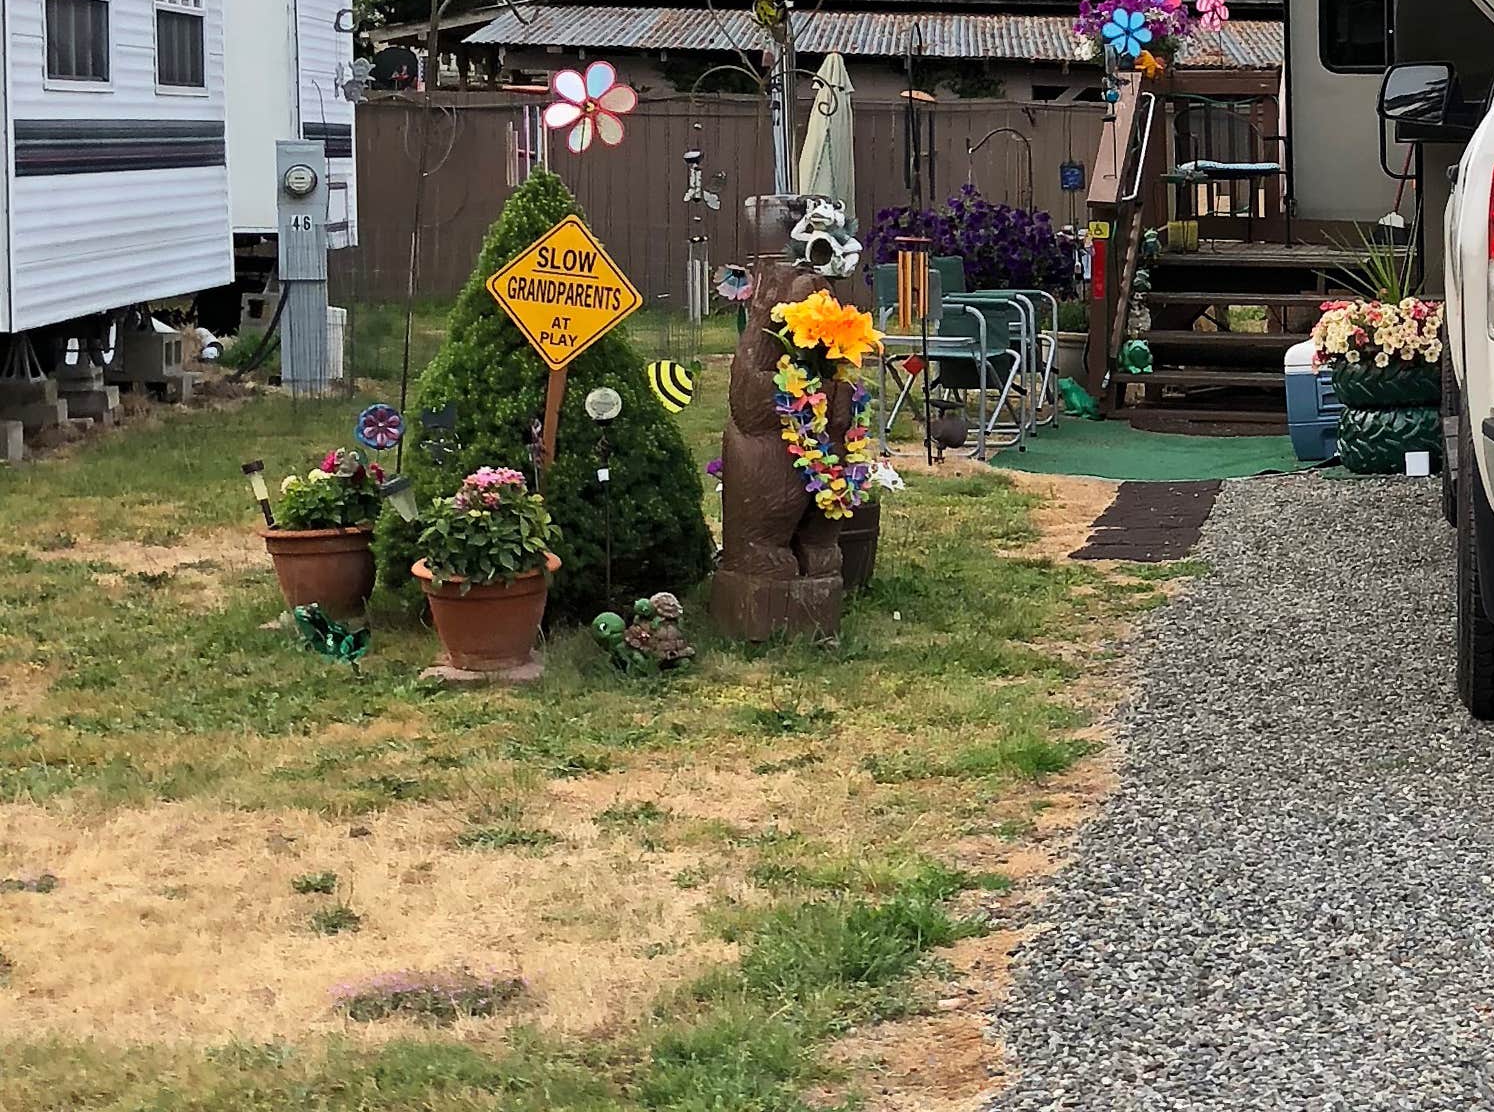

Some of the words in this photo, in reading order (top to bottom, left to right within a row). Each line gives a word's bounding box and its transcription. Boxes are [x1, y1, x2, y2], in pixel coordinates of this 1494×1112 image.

[292, 216, 311, 230] 46
[536, 246, 597, 273] SLOW
[507, 275, 622, 311] GRANDPARENTS
[551, 316, 571, 330] AT
[539, 331, 578, 347] PLAY
